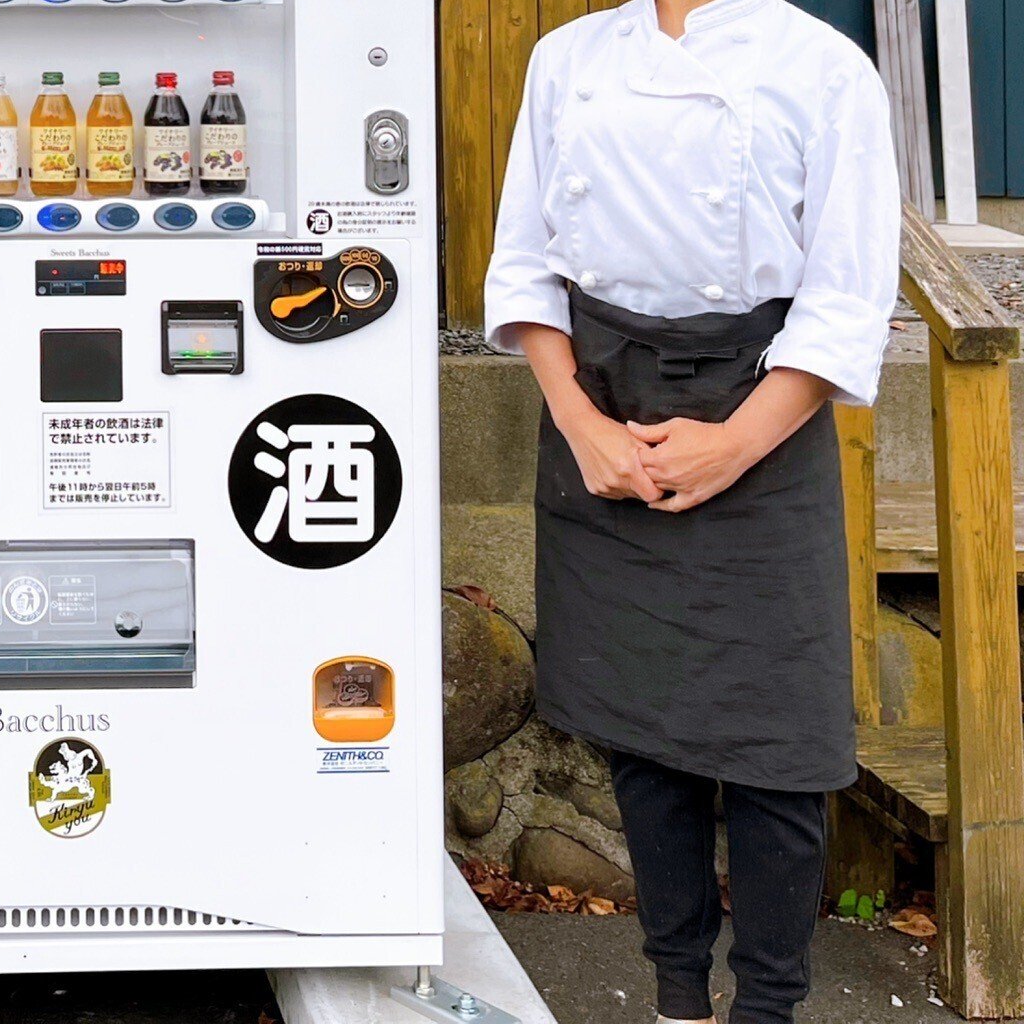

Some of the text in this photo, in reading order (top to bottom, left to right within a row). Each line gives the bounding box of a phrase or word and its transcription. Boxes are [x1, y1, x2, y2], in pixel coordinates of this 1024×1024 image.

[309, 212, 329, 233] 酒
[49, 418, 164, 429] 未成年者の飲酒は法律
[49, 433, 157, 444] で禁止されています。
[49, 482, 156, 491] 午後11時から翌日午前5時
[254, 421, 375, 543] 酒
[49, 494, 166, 503] までは販売を停止しています。
[64, 814, 92, 835] you
